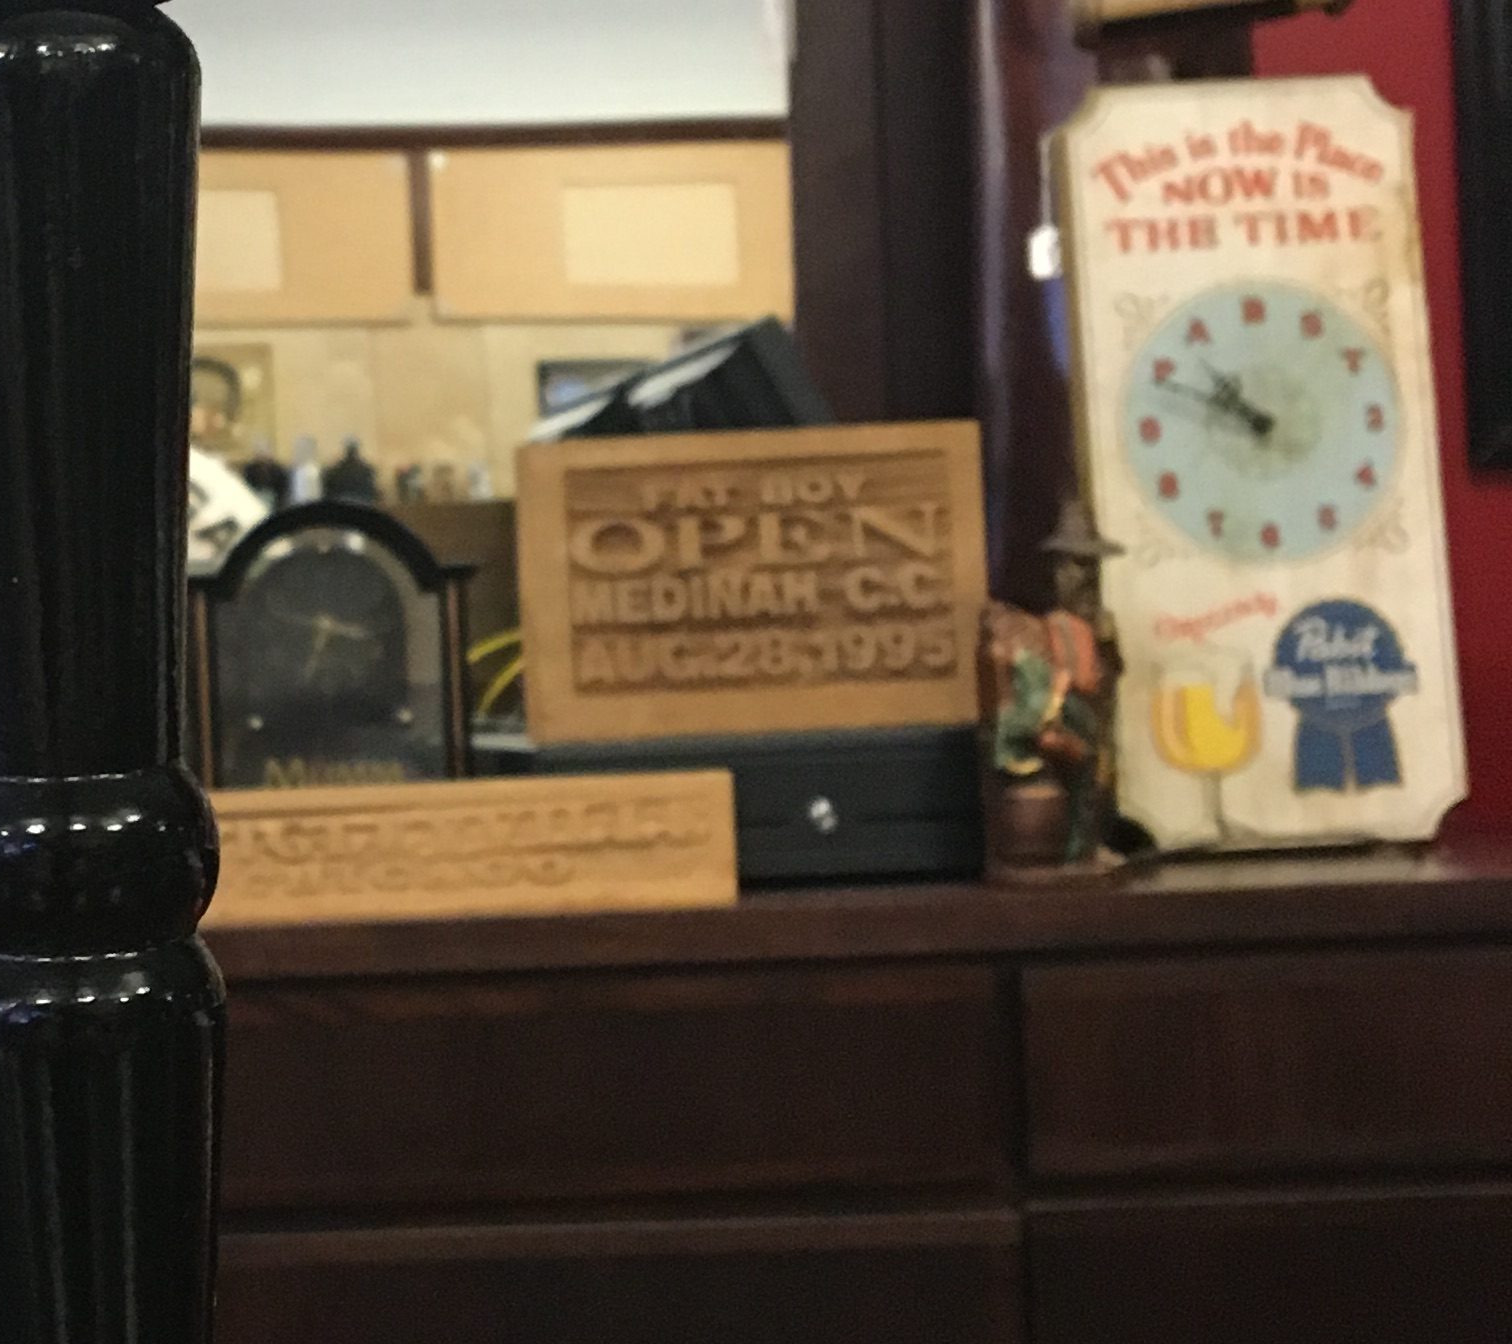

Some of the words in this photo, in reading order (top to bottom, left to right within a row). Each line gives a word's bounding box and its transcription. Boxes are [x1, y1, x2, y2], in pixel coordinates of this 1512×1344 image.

[1092, 144, 1178, 203] This
[1185, 130, 1216, 161] is
[1228, 119, 1284, 156] the
[1294, 120, 1384, 183] Place
[1163, 166, 1279, 205] NOW
[1104, 215, 1221, 254] THE
[1234, 206, 1385, 248] TIME
[568, 501, 942, 574] OPEN
[572, 567, 820, 624] MEDINAH
